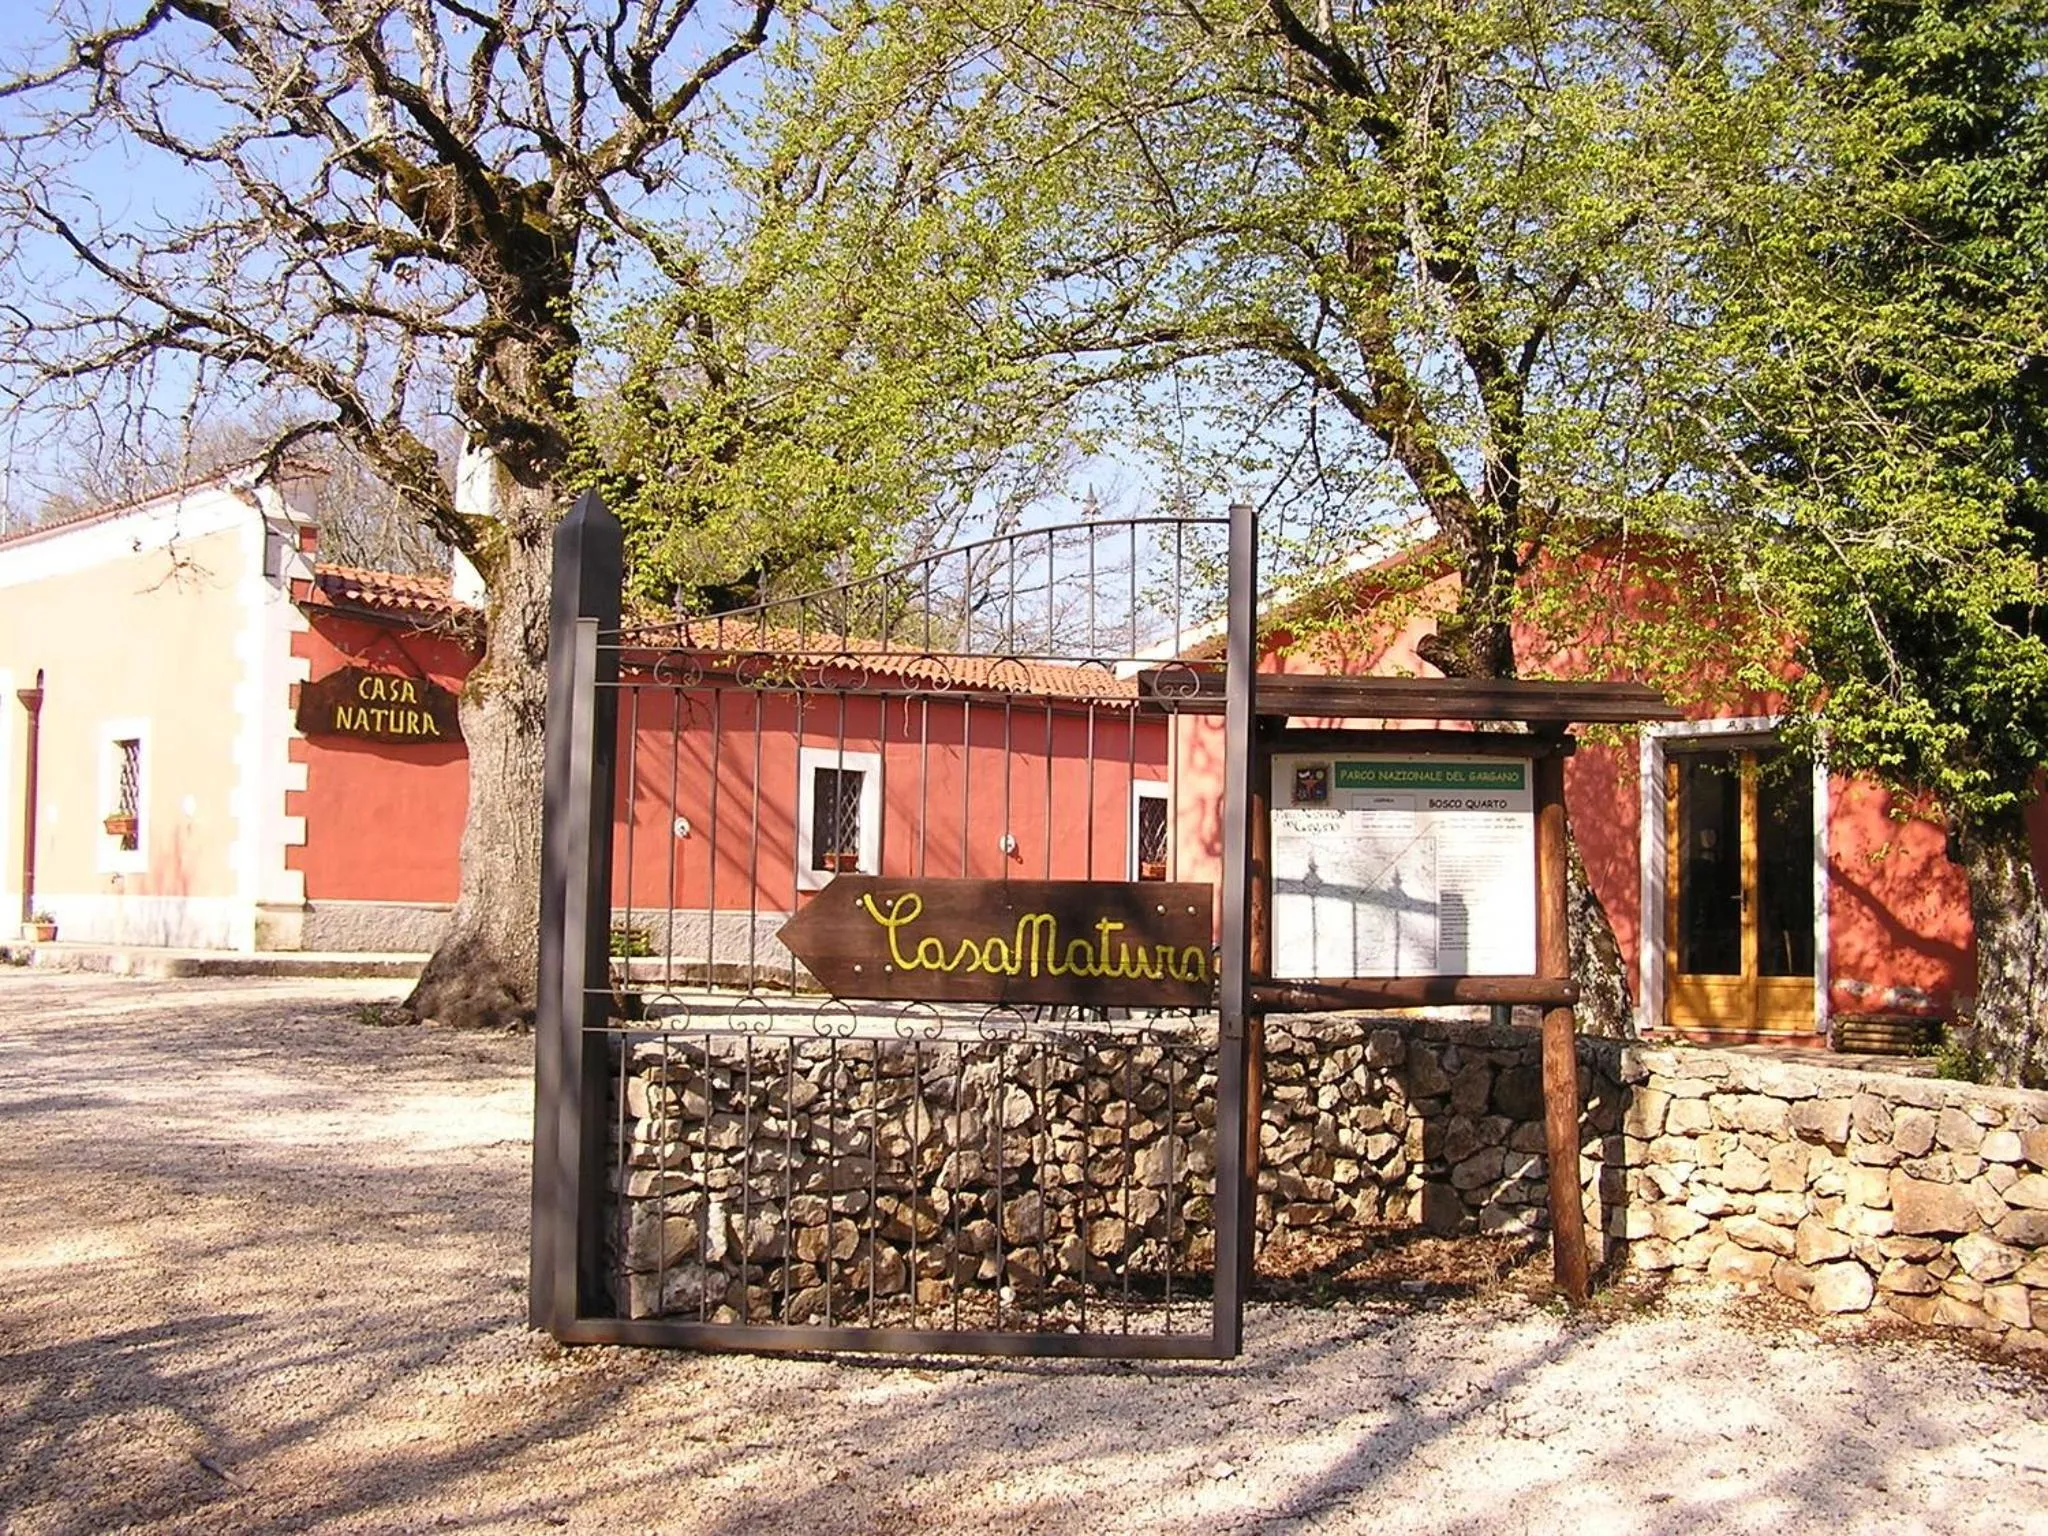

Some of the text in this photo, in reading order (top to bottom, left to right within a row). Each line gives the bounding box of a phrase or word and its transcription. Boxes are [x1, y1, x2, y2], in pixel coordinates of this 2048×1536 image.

[358, 676, 417, 704] CASA
[336, 706, 440, 736] NATURA
[1340, 768, 1520, 783] PARCO NAZIONALE DEL GARGANO
[1429, 799, 1508, 811] BOSCO QUARTO
